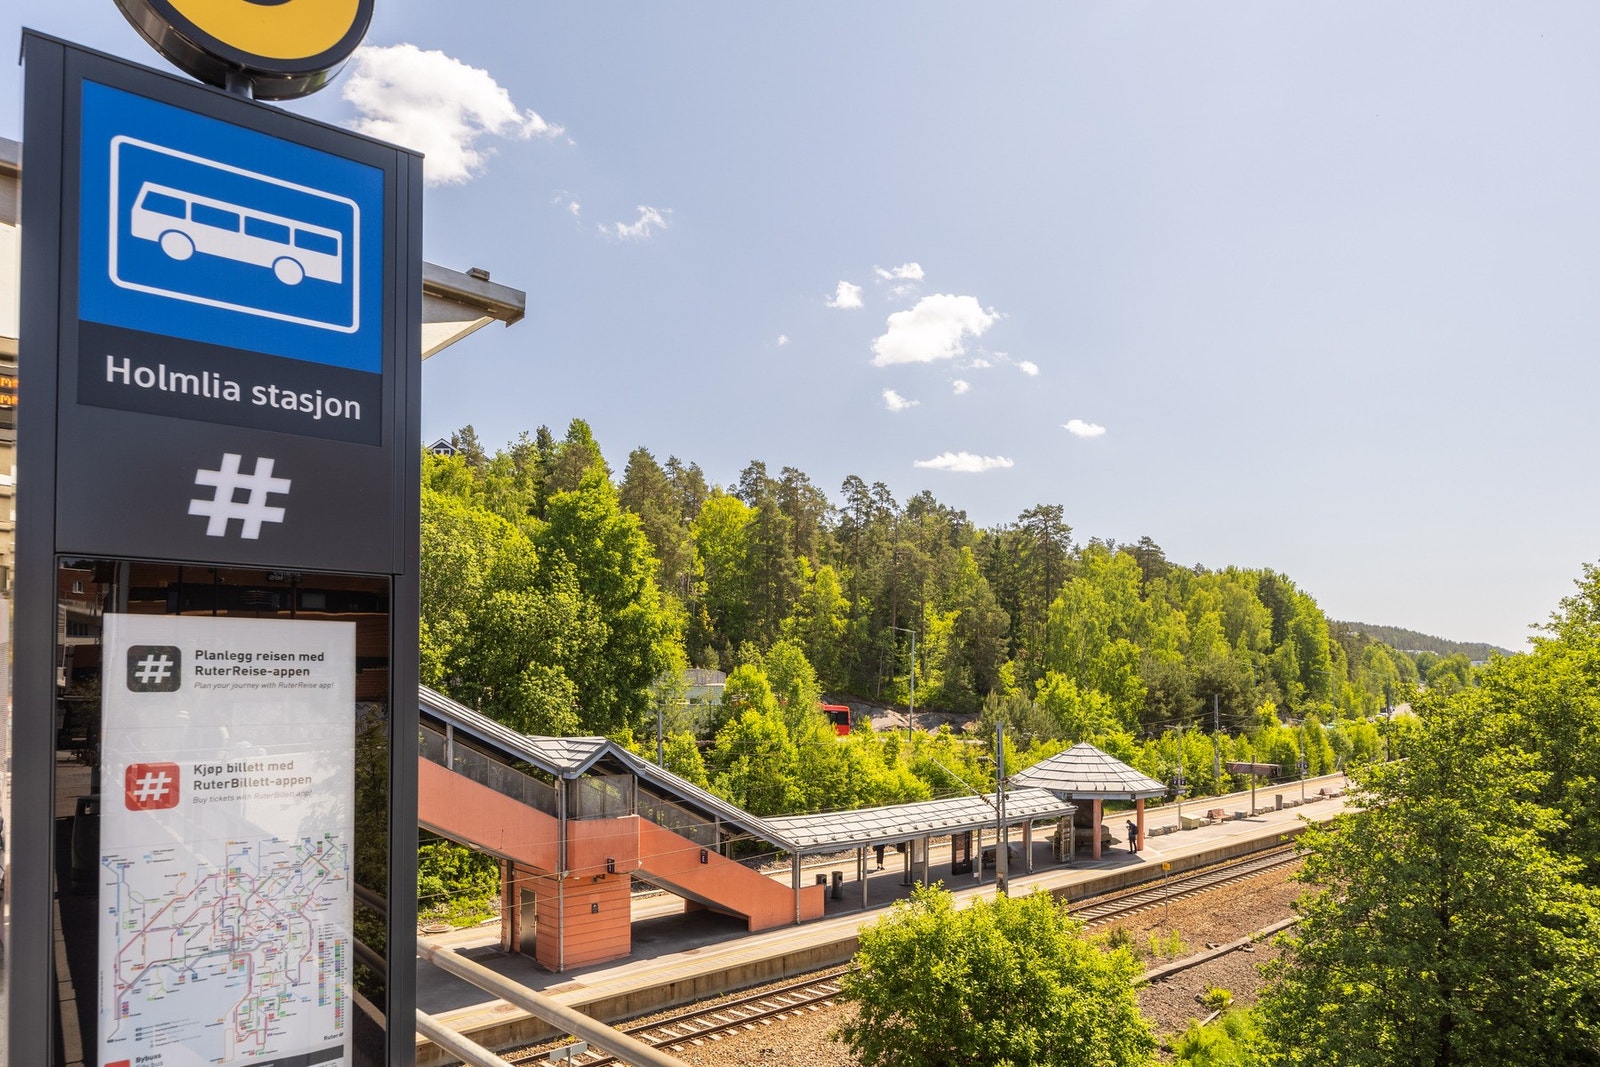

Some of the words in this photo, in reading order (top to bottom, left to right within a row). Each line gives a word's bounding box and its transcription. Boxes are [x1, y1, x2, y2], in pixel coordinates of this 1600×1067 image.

[105, 354, 241, 402] Holmlia
[251, 382, 362, 421] stasjon
[194, 649, 253, 662] Planlegg
[256, 651, 295, 661] reisen
[298, 651, 325, 662] med
[194, 665, 311, 678] RuterReise-appen
[193, 681, 212, 690] Plan
[212, 682, 230, 691] your
[231, 682, 260, 691] journey
[261, 682, 277, 690] with
[279, 682, 318, 690] RuterReise
[318, 682, 335, 691] app!
[193, 764, 223, 776] Kjøp
[227, 761, 264, 773] billett
[267, 760, 294, 771] med
[193, 776, 313, 790] RuterBillett-appen
[192, 796, 208, 804] Buy
[209, 795, 235, 803] tickets
[236, 793, 253, 801] with
[254, 791, 295, 799] RuterBillett
[295, 789, 313, 798] app!
[136, 1054, 162, 1063] Bybuss
